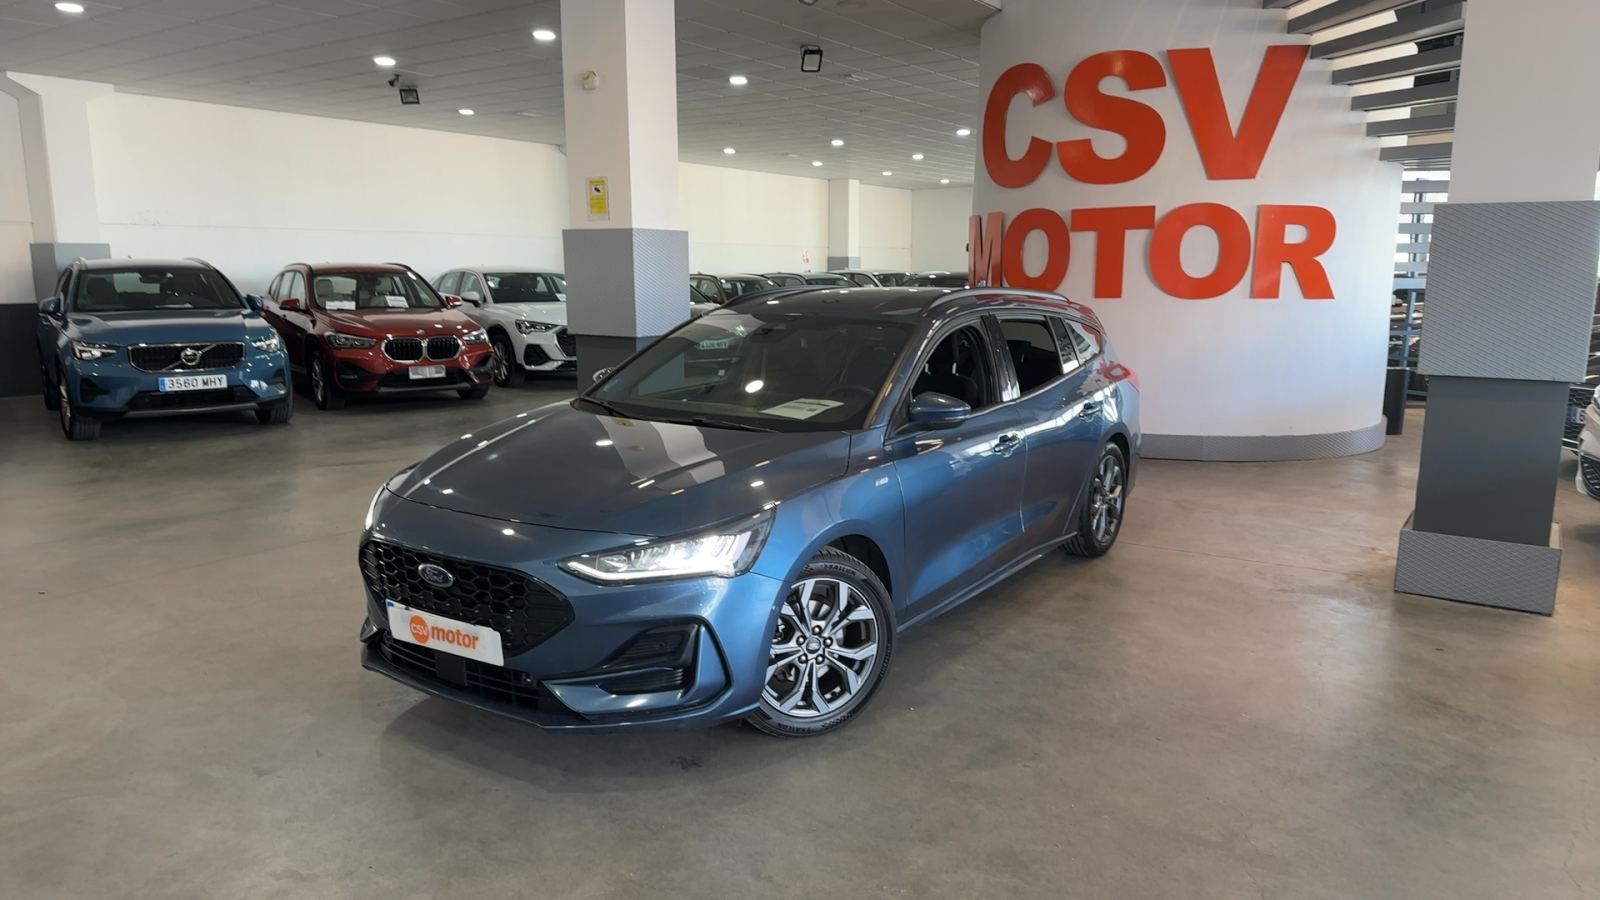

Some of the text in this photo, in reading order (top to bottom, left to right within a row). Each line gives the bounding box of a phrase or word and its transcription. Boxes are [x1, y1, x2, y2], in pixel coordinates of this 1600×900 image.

[982, 45, 1310, 188] CSV
[969, 202, 1336, 299] MOTOR
[168, 376, 222, 389] 3560 MHY
[431, 626, 479, 649] motor
